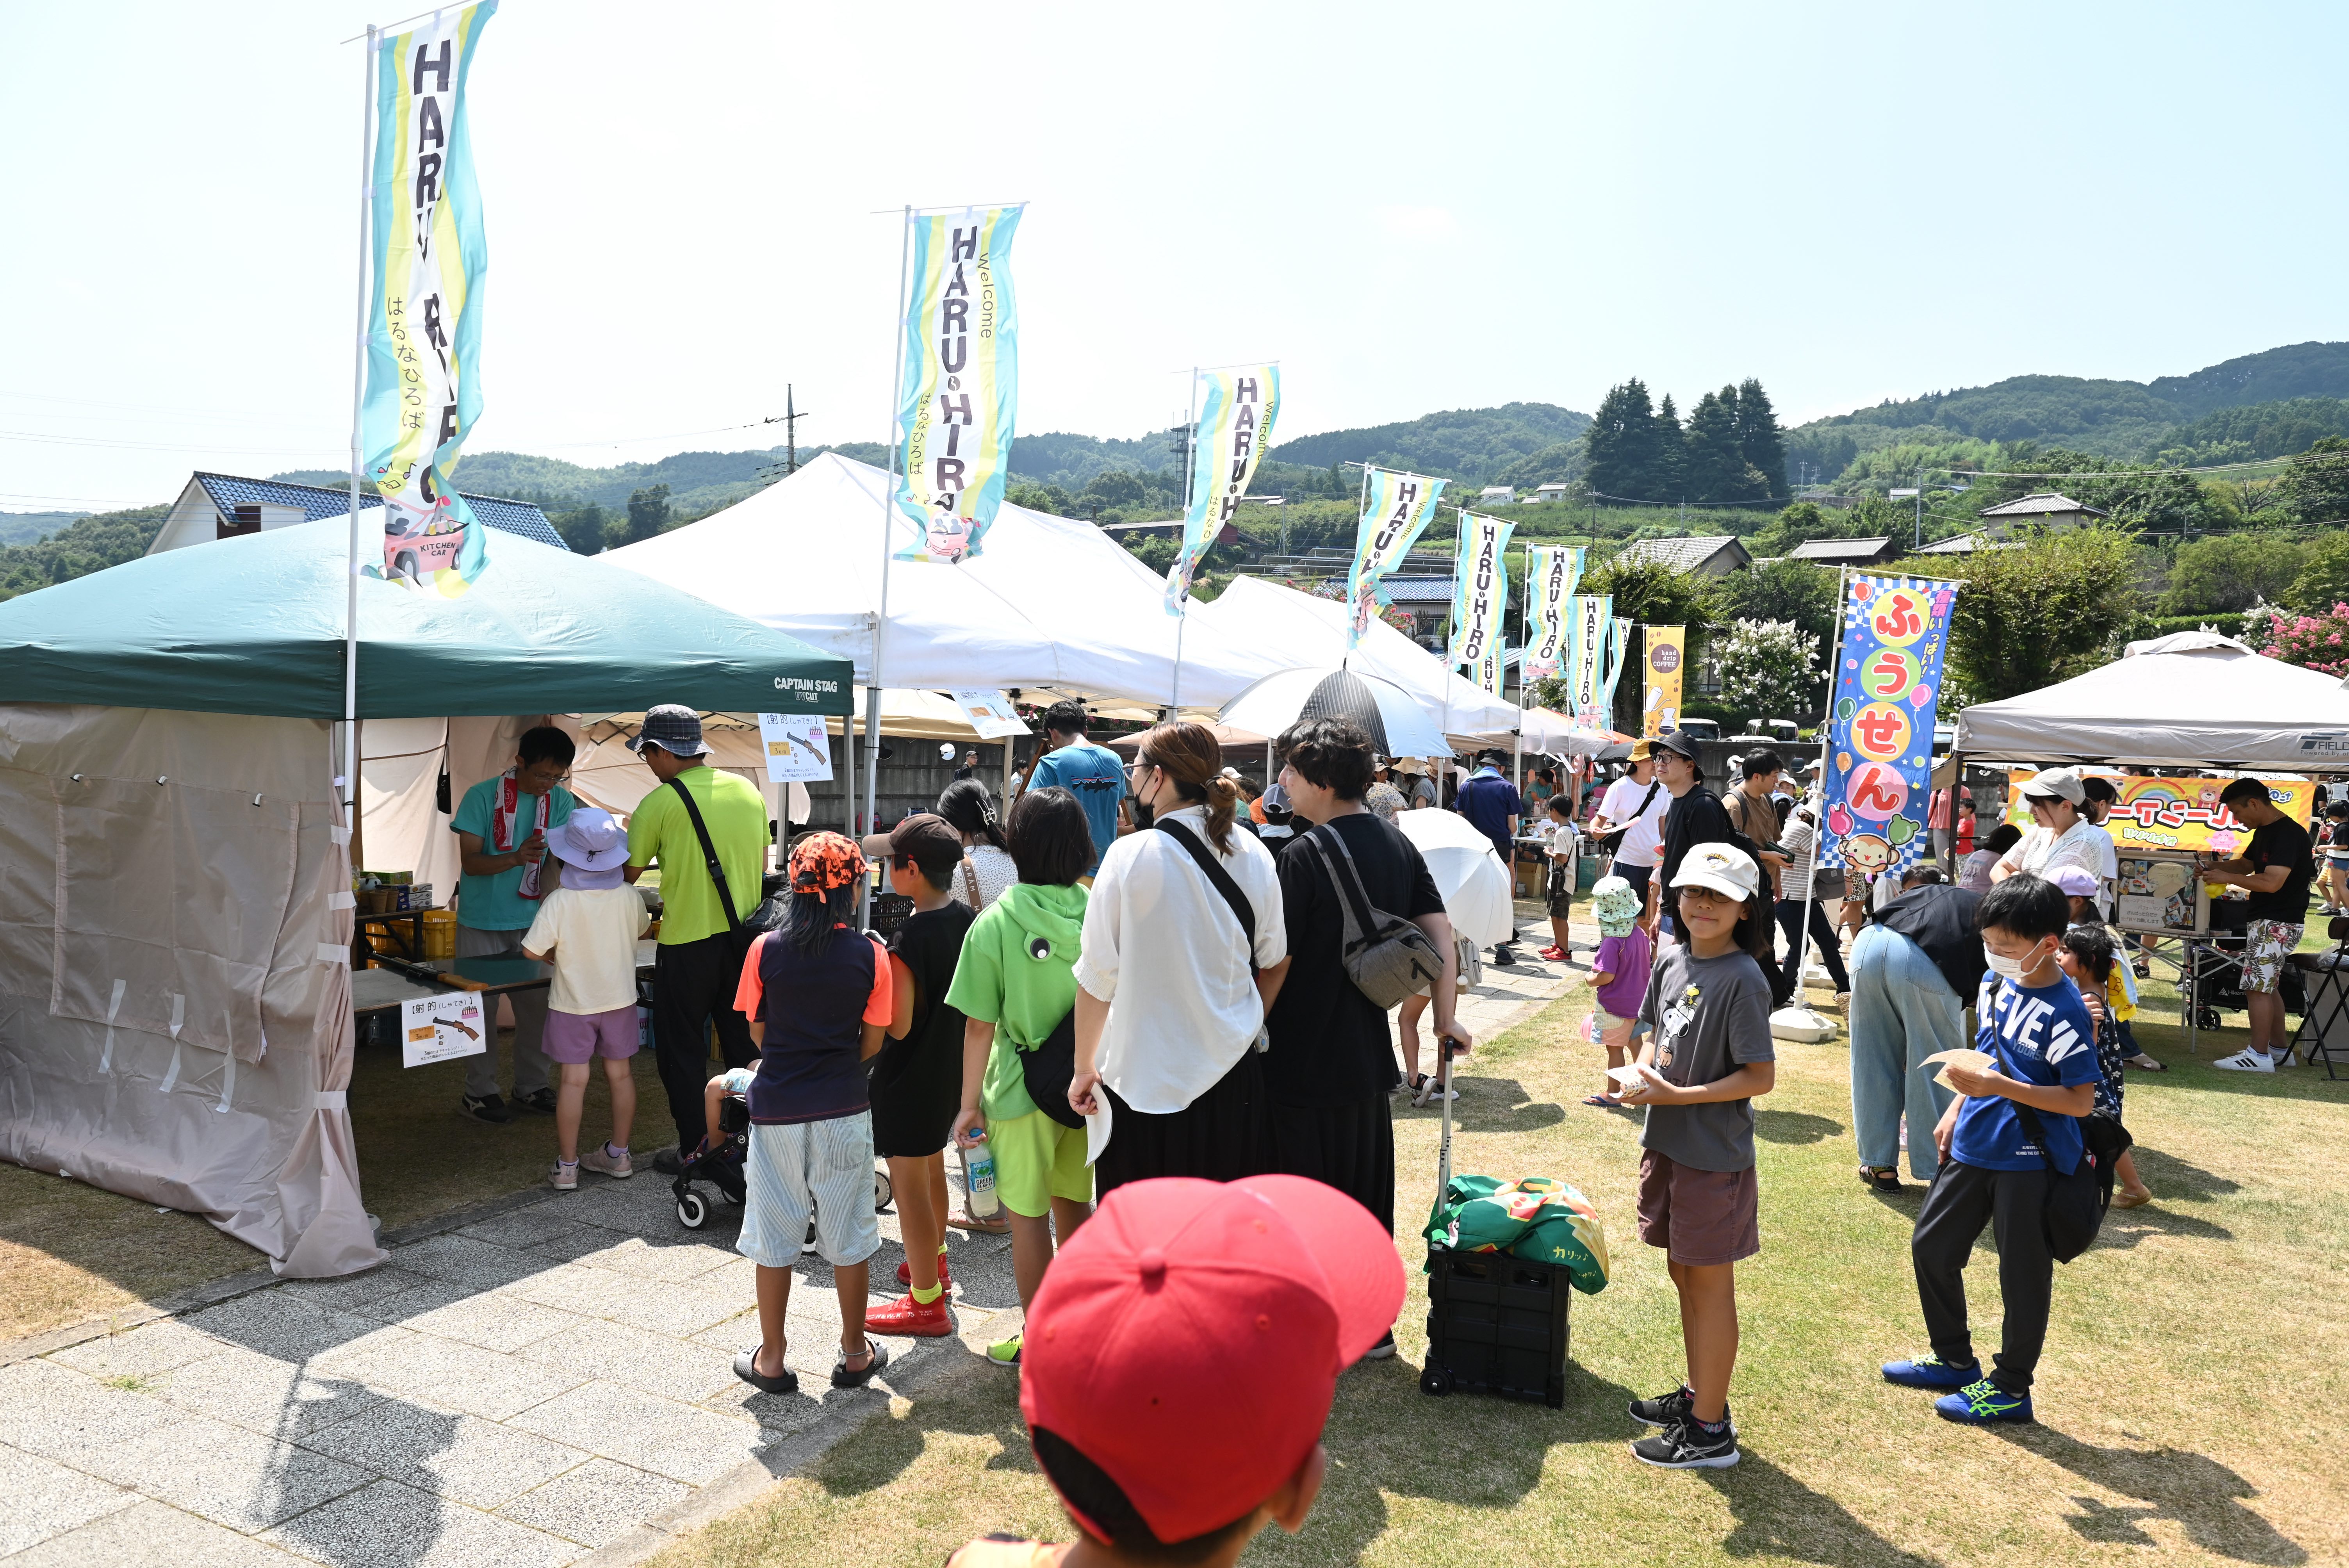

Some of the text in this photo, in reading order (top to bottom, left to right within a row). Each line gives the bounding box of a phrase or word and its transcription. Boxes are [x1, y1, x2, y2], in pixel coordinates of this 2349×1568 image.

[941, 225, 977, 373] HARU
[977, 252, 994, 339] Welcome
[388, 297, 425, 429] はるなひろば
[909, 393, 931, 475] はるなひろば
[1232, 378, 1257, 483] HARU
[420, 542, 456, 552] KITCHEN
[1466, 525, 1495, 659] HARU HIRO
[1540, 551, 1565, 659] HARU HIRO
[1581, 601, 1596, 704] HARU HIRO
[774, 677, 838, 693] CAPTAIN STAG
[1851, 594, 1921, 811] ふうせん
[976, 1176, 992, 1185] GREEN
